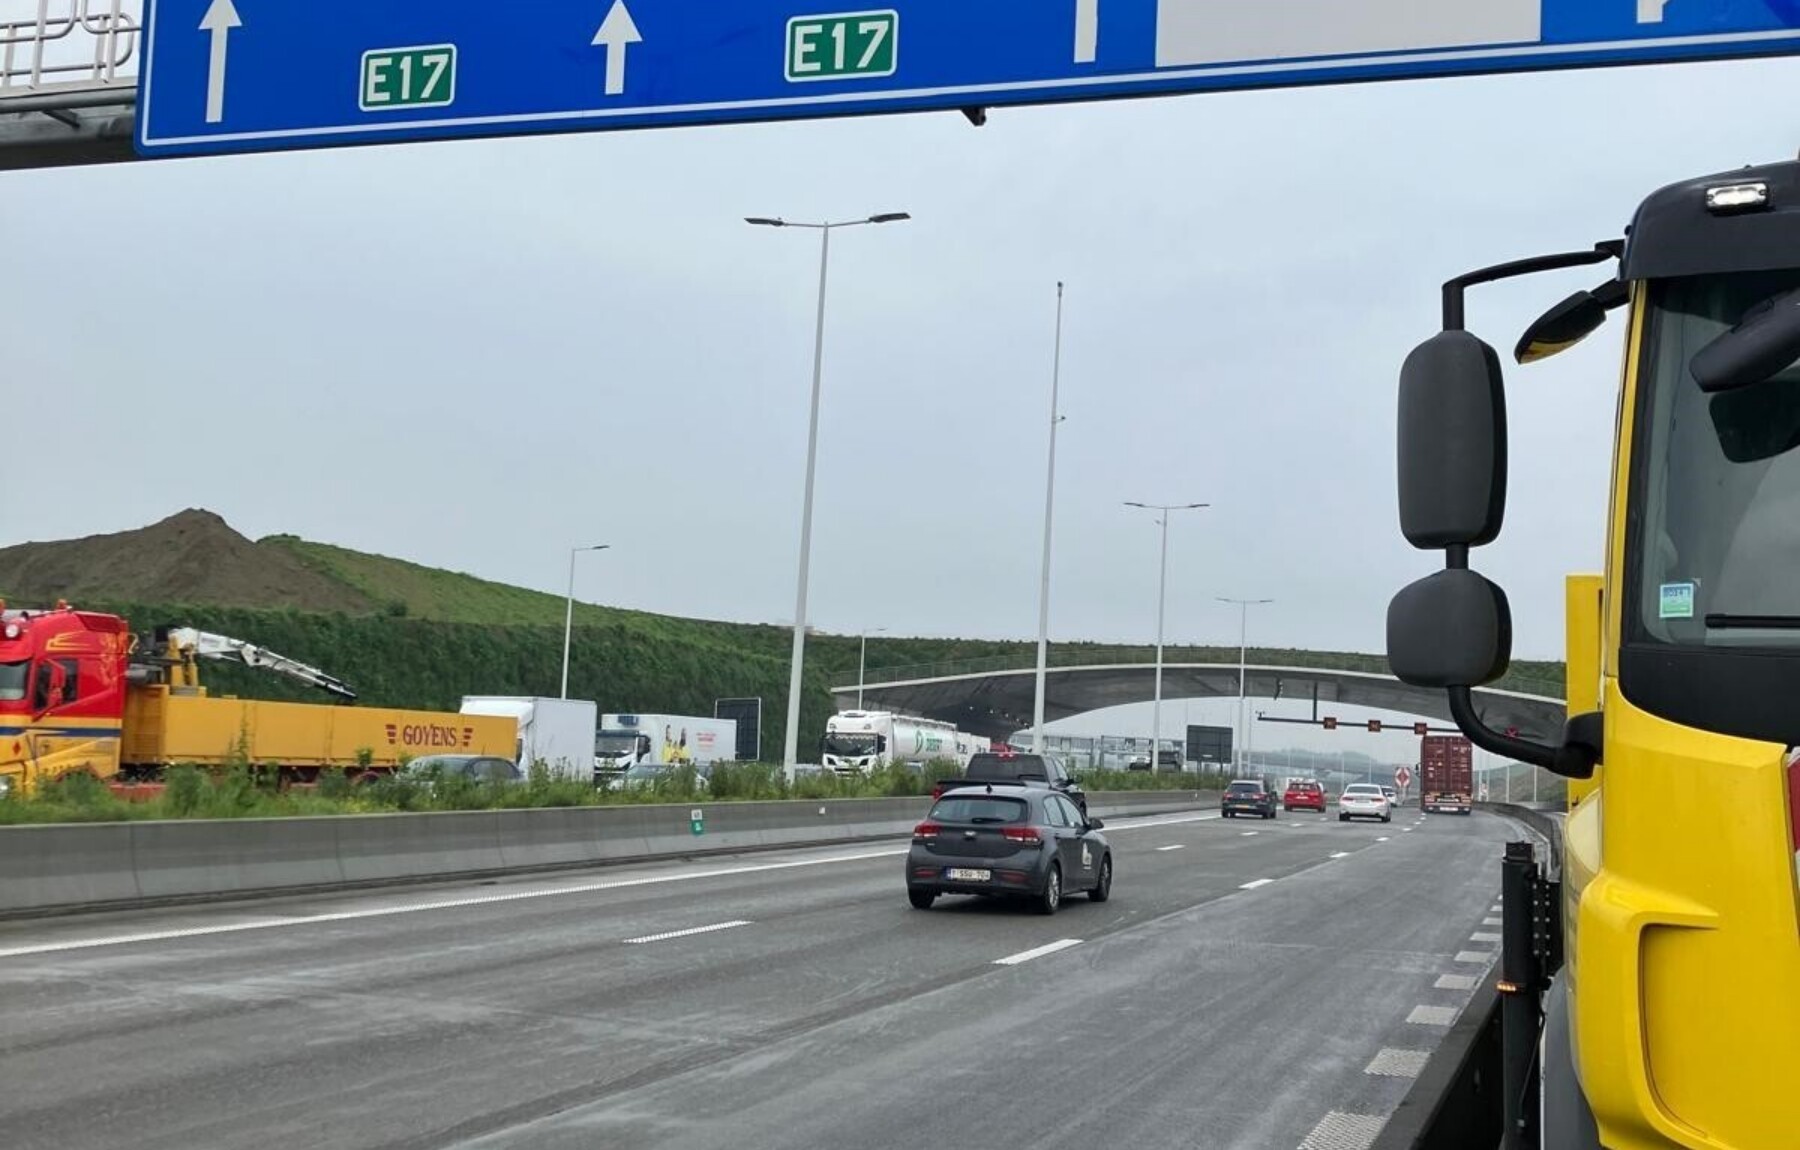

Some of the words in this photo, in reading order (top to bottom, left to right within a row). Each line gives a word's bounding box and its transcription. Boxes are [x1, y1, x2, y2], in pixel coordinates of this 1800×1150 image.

[794, 20, 889, 73] E17
[366, 53, 449, 102] E17
[403, 724, 457, 747] GOYENS
